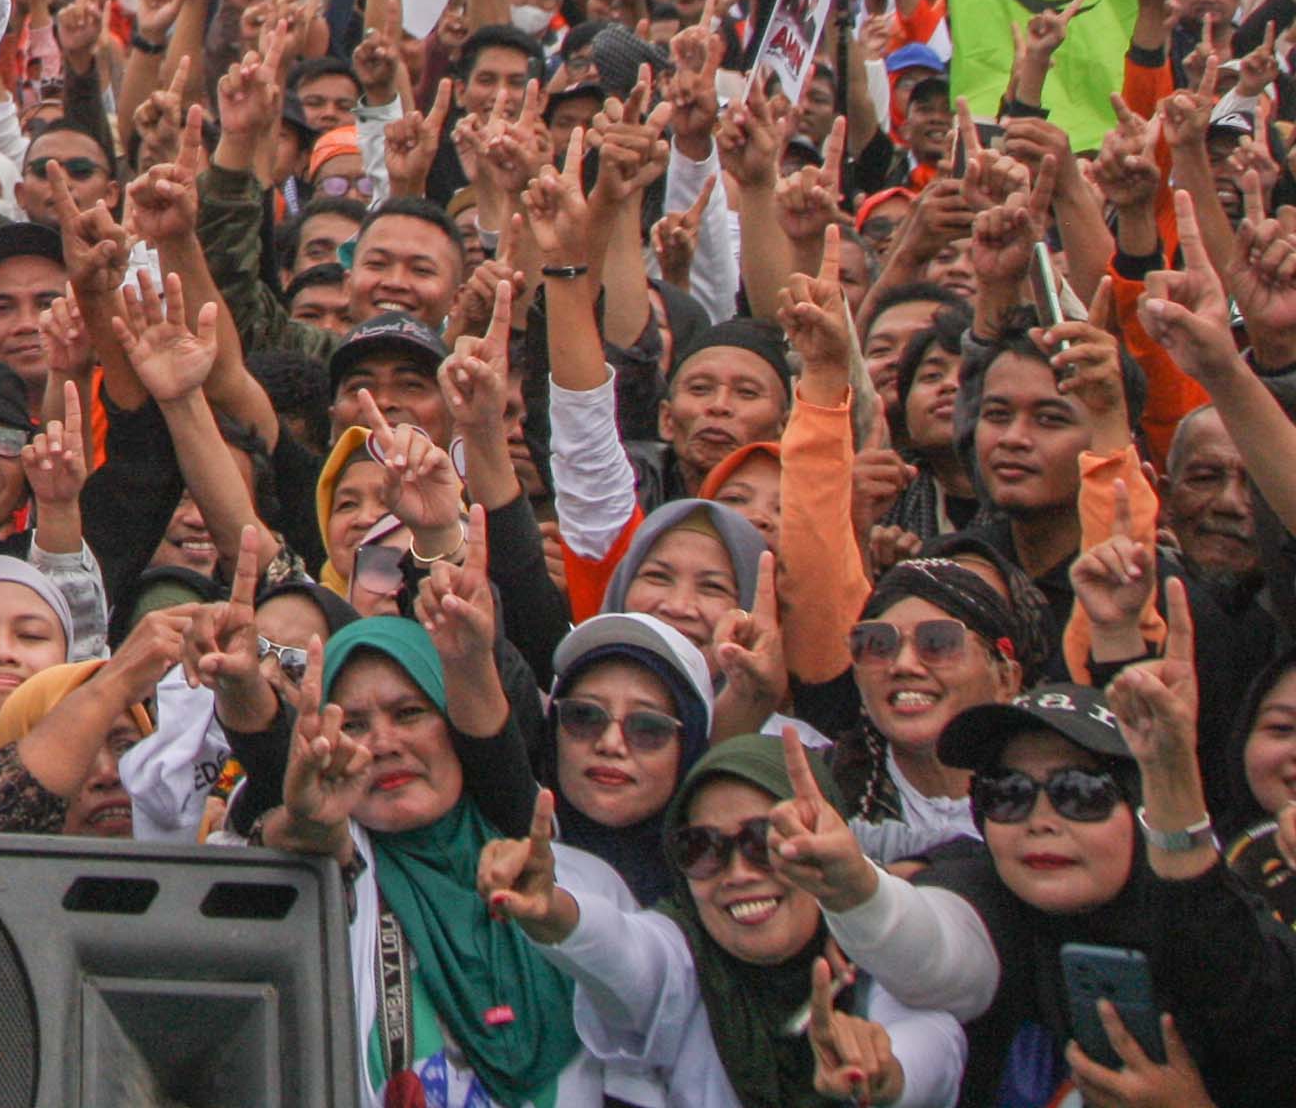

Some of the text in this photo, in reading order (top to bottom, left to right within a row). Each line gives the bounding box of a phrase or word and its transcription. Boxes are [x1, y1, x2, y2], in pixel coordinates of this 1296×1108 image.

[380, 913, 405, 1040] BIMBA Y LOLA
